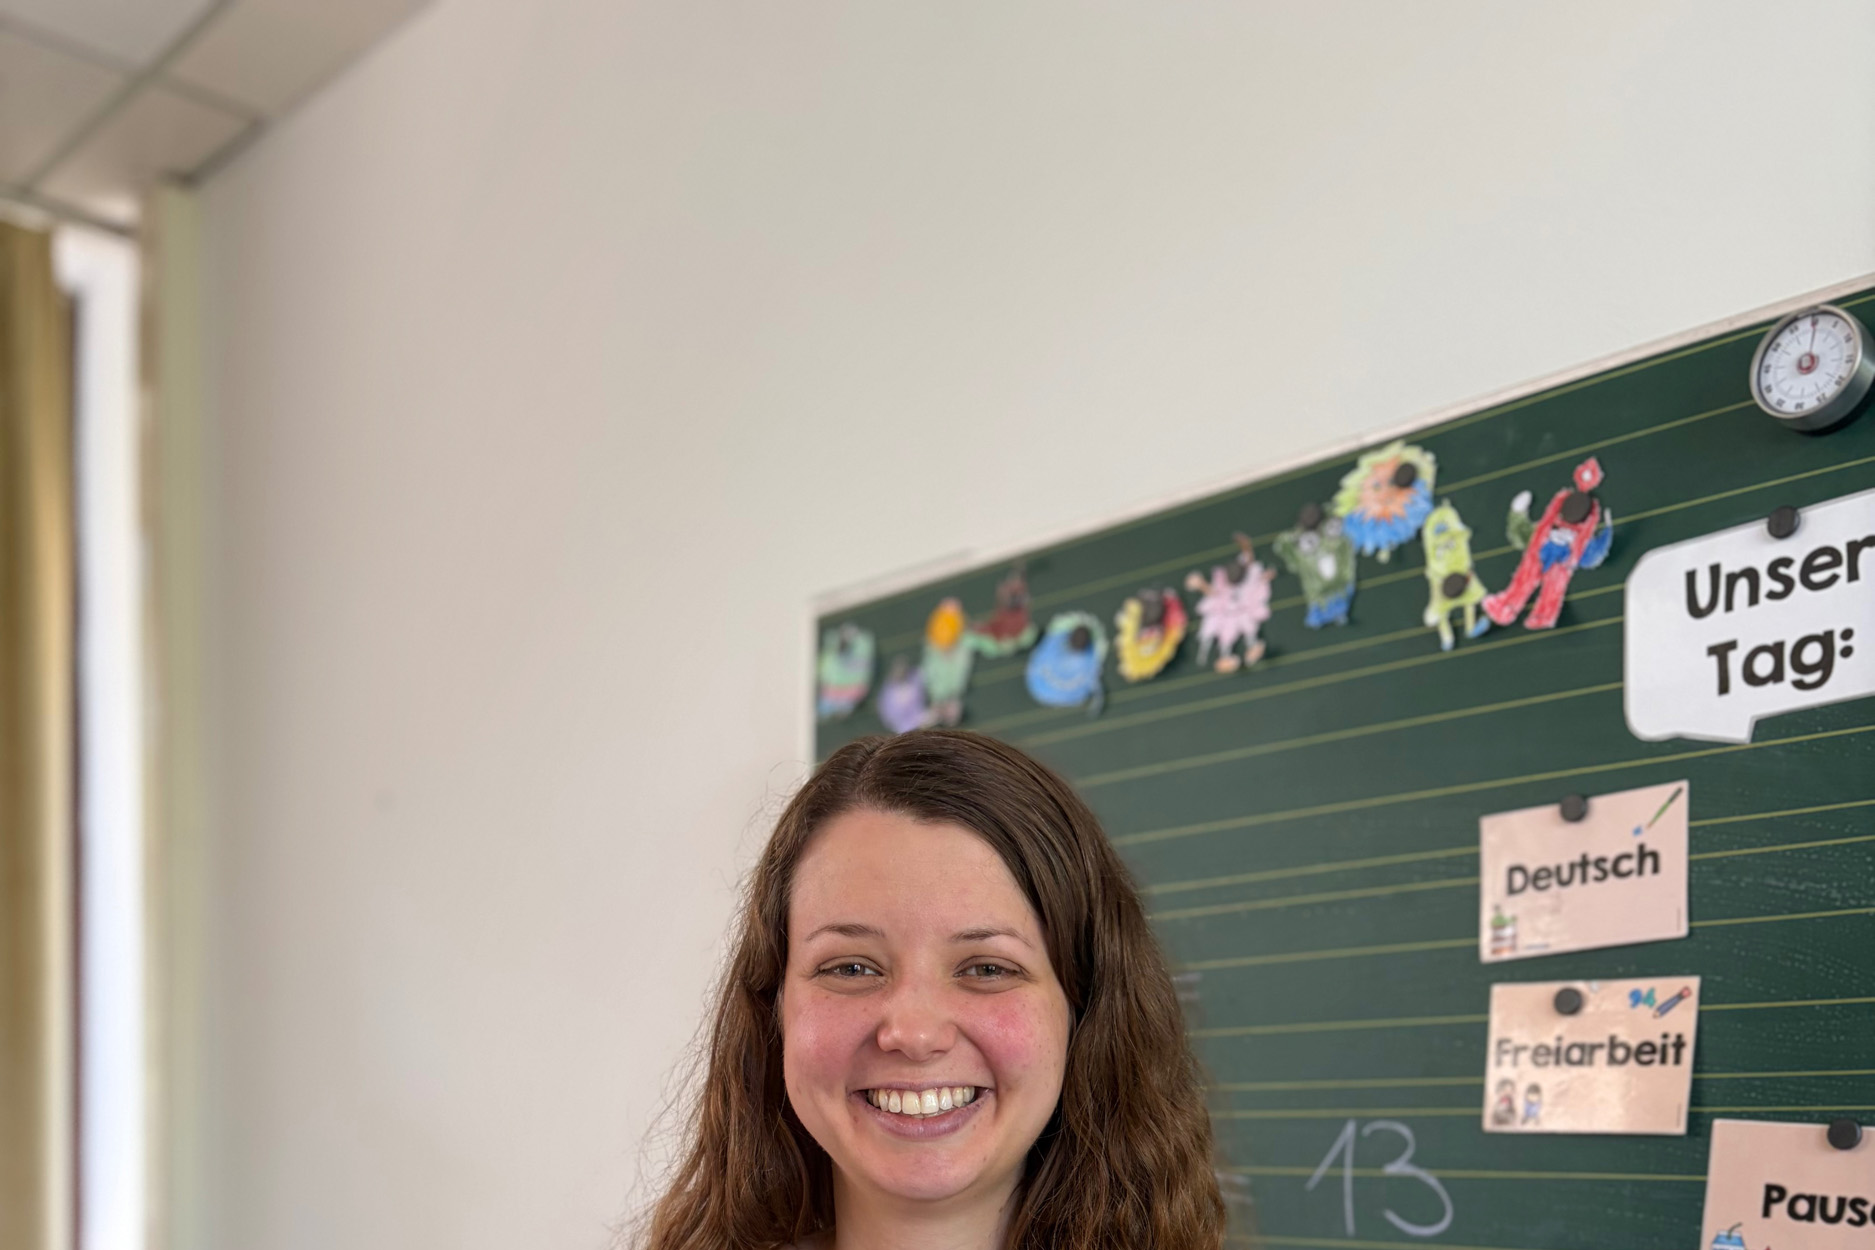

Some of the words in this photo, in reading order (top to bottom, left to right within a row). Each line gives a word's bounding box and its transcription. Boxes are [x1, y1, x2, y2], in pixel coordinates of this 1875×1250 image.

[1706, 628, 1854, 697] Tag:
[1506, 842, 1660, 896] Deutsch
[1495, 1032, 1686, 1067] Freiarbeit
[1305, 1119, 1453, 1237] 13
